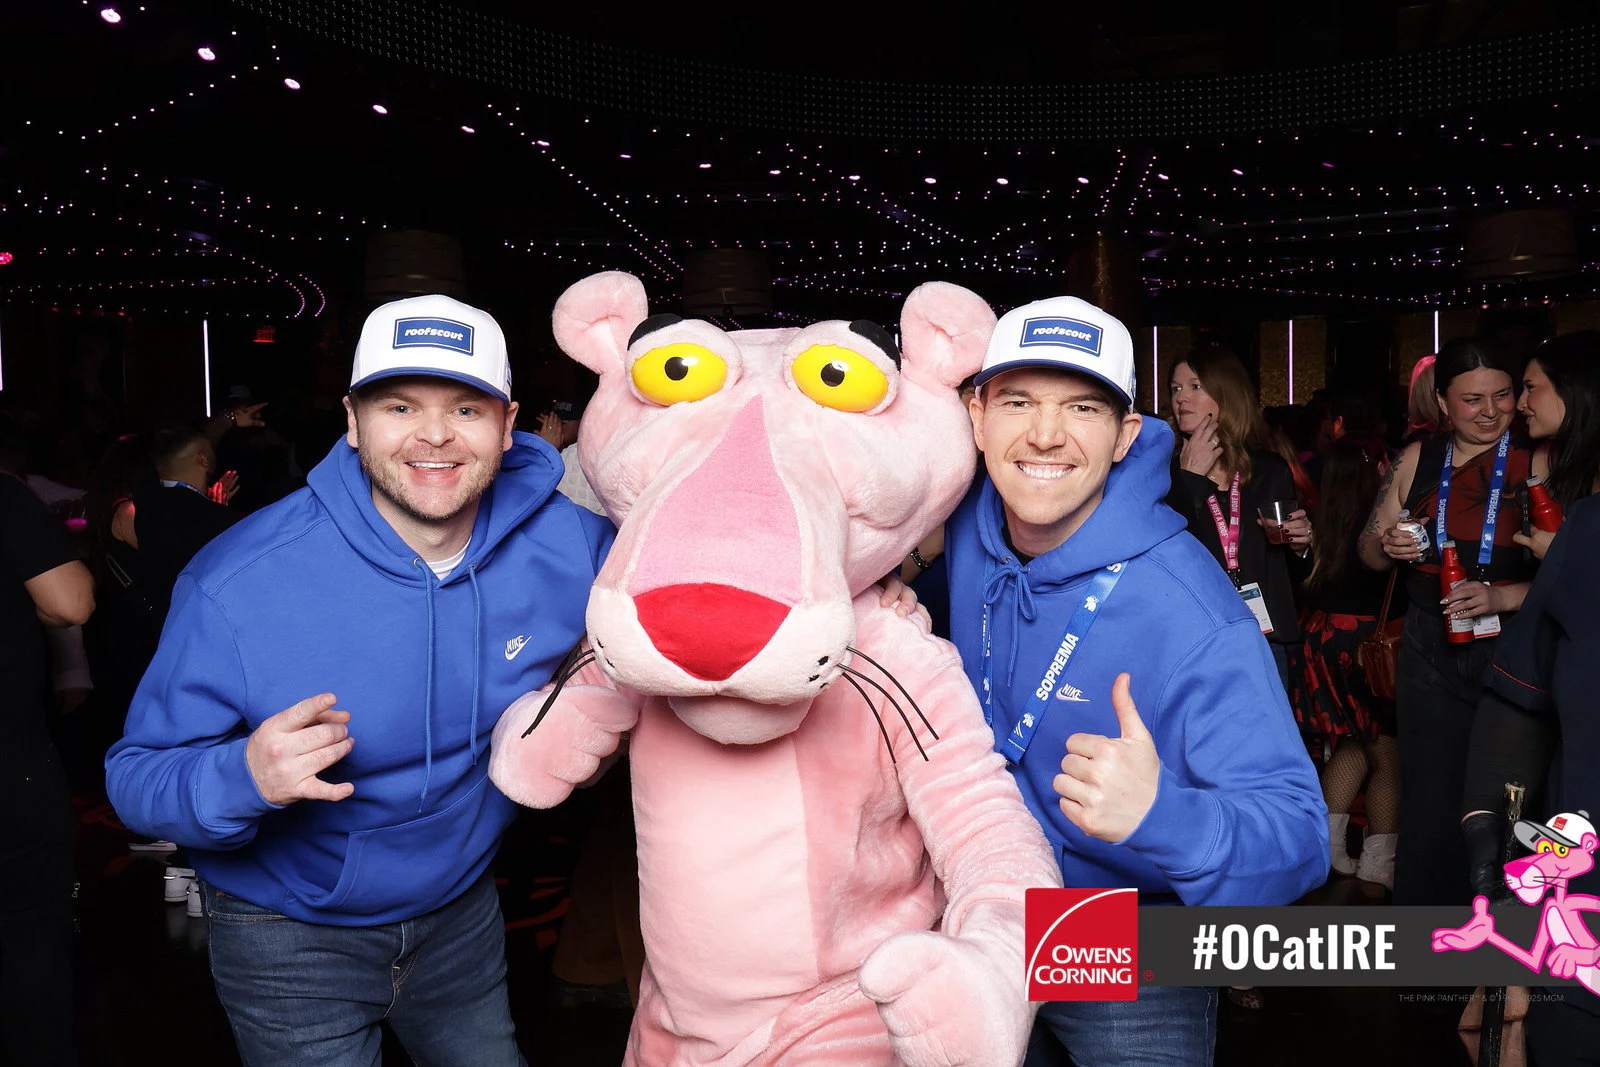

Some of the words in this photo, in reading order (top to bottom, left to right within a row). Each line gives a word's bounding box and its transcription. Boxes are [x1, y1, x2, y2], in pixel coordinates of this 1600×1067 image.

[404, 327, 464, 341] roofscout
[1032, 326, 1092, 341] roofscout
[1498, 431, 1510, 458] SOPRE
[1210, 503, 1222, 516] JUST
[1231, 496, 1239, 513] MORE
[1486, 488, 1501, 525] SOPREMA
[1437, 498, 1447, 534] SOPREMA
[506, 635, 524, 653] NIKE
[1036, 632, 1080, 701] SOPREMA
[1063, 684, 1083, 699] NIKE
